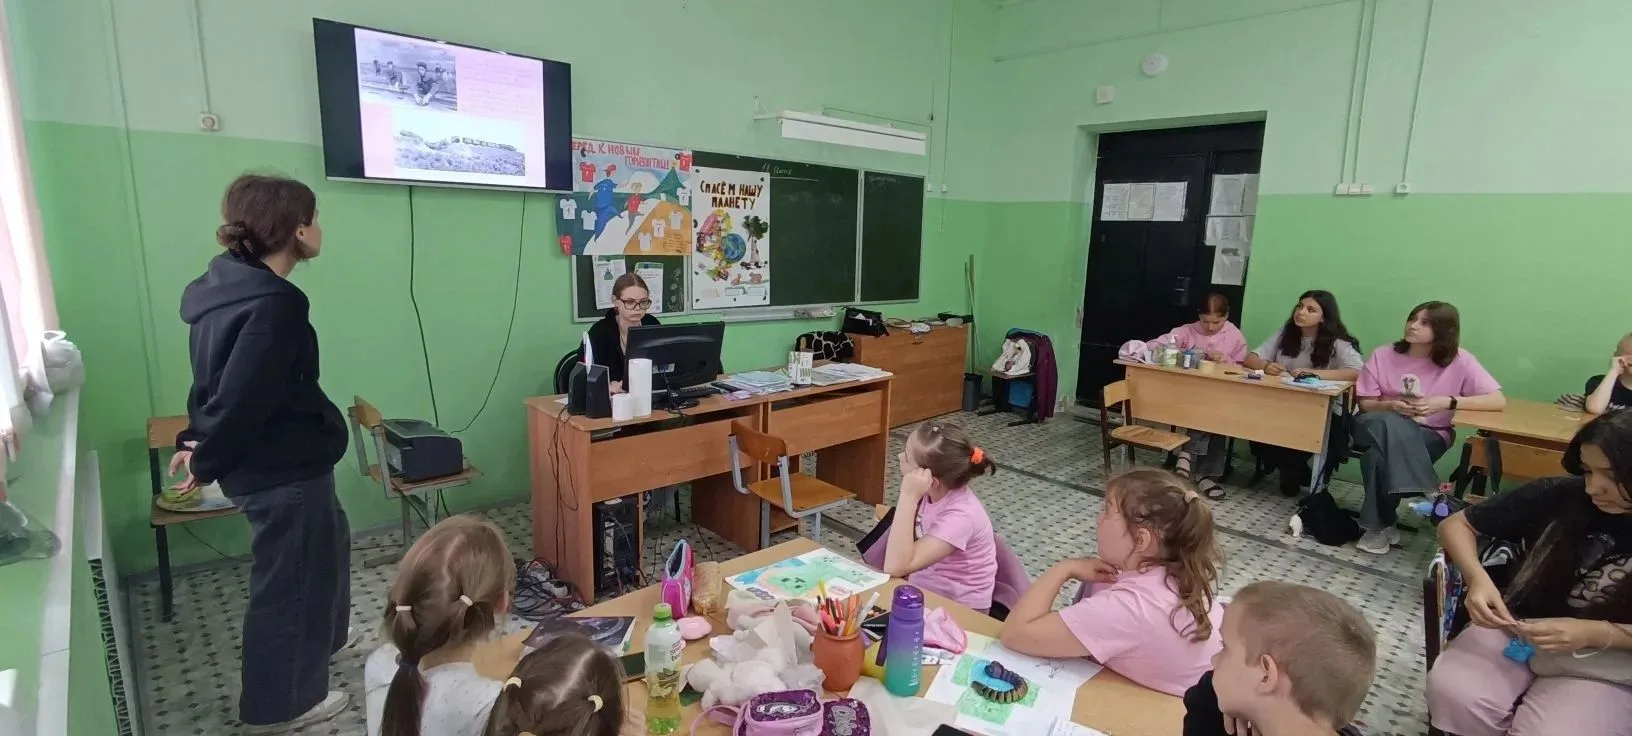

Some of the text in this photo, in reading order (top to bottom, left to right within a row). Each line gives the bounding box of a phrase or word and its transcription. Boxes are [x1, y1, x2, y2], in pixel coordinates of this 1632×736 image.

[599, 143, 606, 154] К
[739, 184, 763, 197] НАШУ
[712, 197, 755, 210] ПЛАНЕТУ
